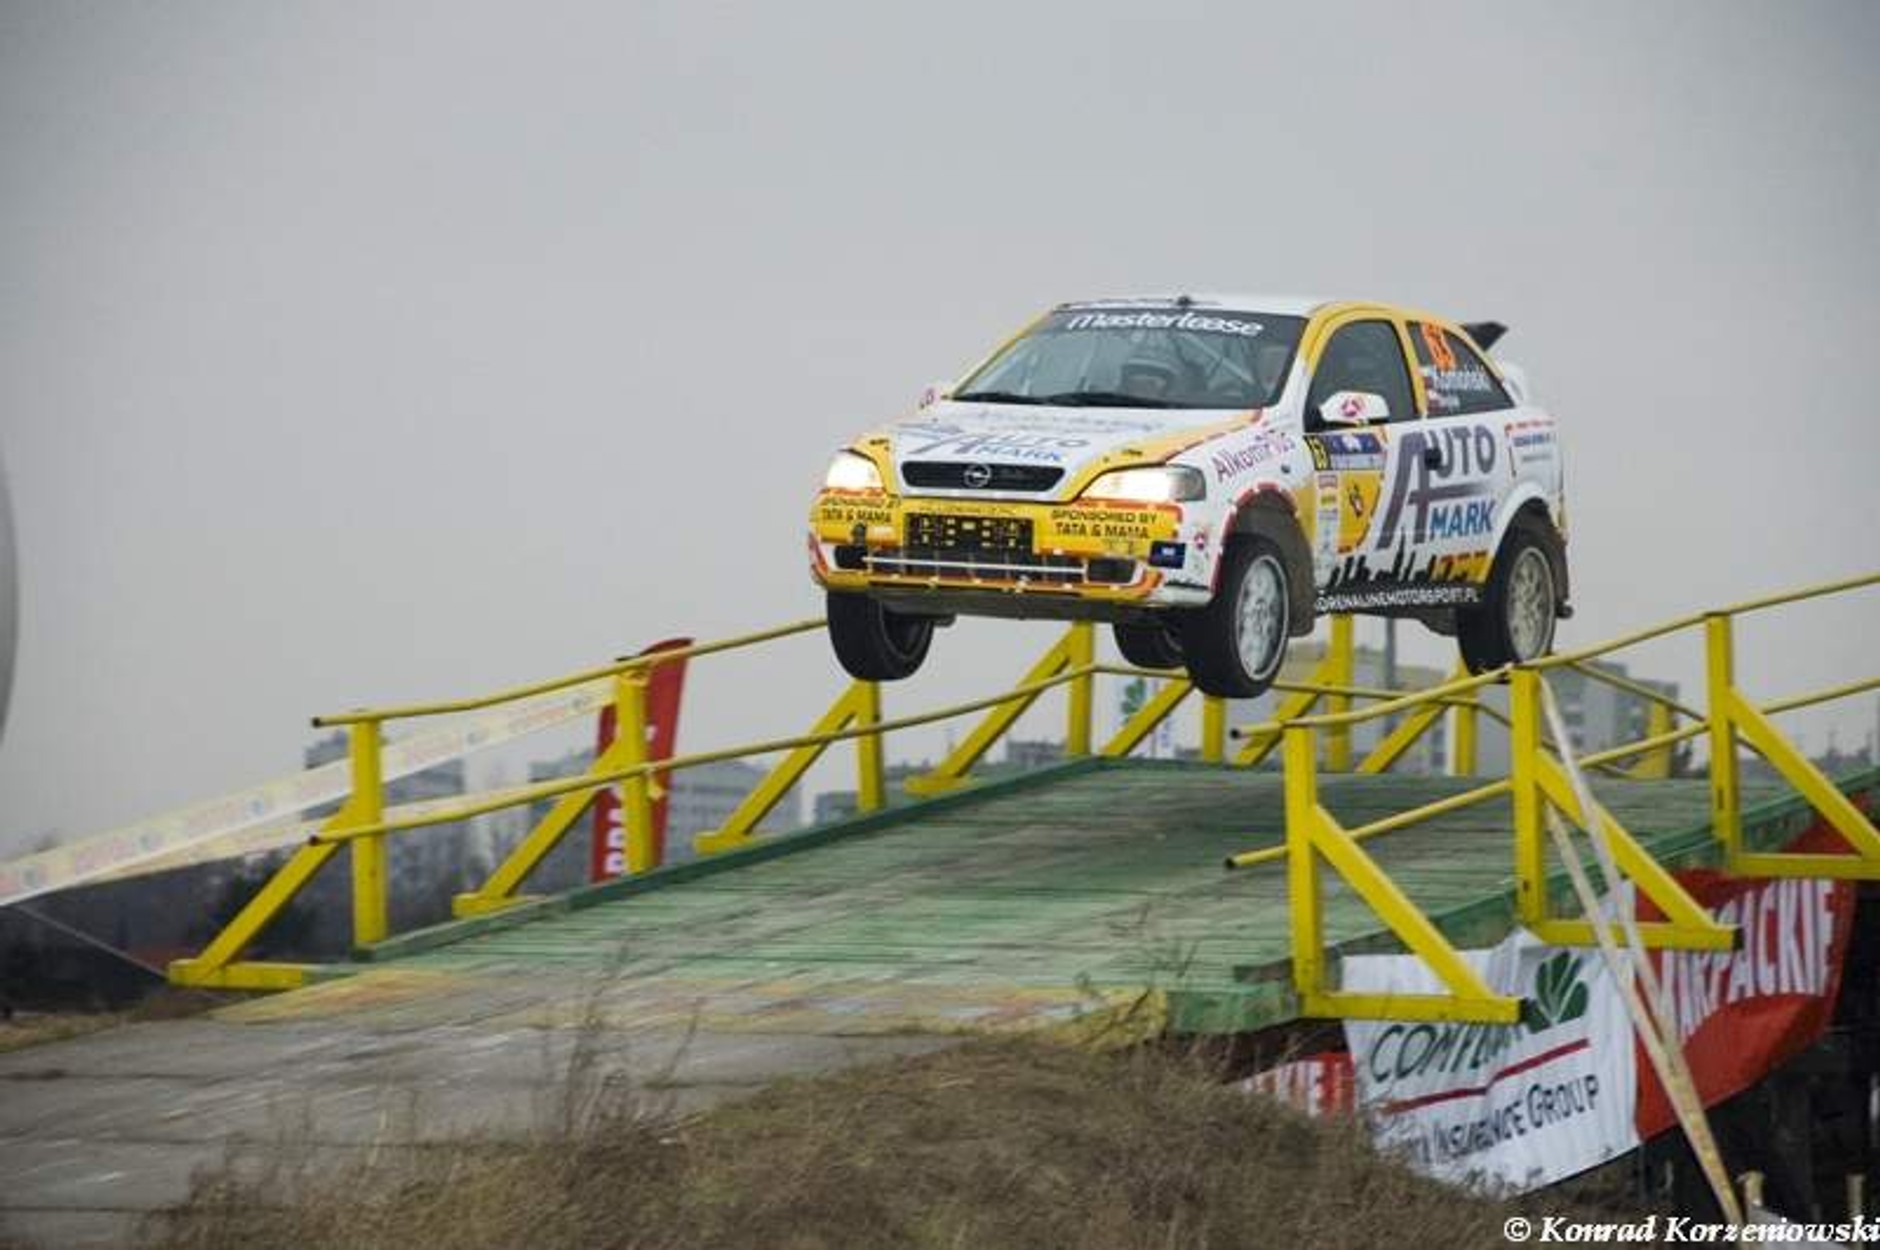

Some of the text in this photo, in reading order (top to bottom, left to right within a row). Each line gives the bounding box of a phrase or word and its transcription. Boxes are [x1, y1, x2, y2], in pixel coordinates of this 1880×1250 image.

[1375, 424, 1496, 551] AUTO
[1051, 508, 1158, 524] SPONSORED BY
[1055, 522, 1151, 539] TATA & MAMA
[1429, 498, 1497, 542] MARK
[1527, 1074, 1600, 1128] GROUP
